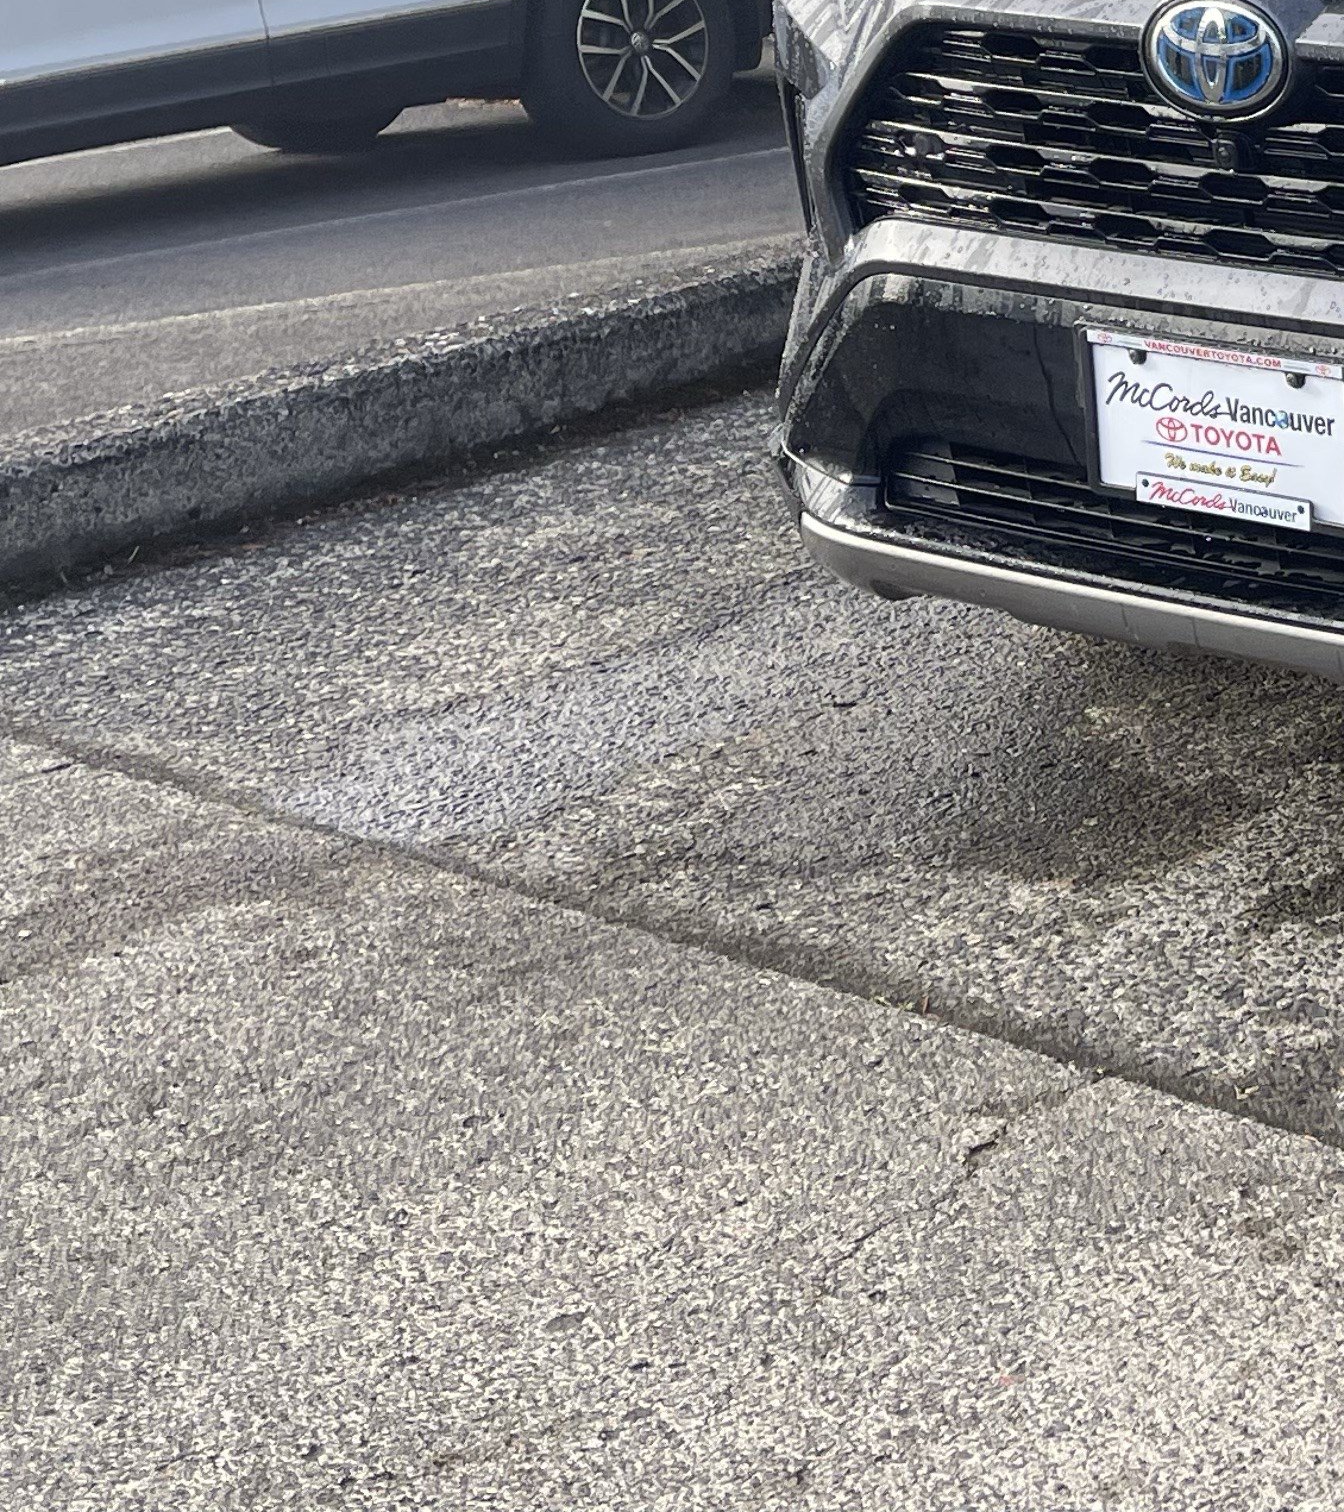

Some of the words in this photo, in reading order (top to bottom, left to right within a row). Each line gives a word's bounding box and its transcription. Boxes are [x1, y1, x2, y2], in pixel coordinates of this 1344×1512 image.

[1143, 339, 1282, 368] VANCOUVERTOYOTA.COM
[1192, 424, 1283, 456] TOYOTA
[1164, 452, 1186, 470] We
[1189, 460, 1222, 476] make
